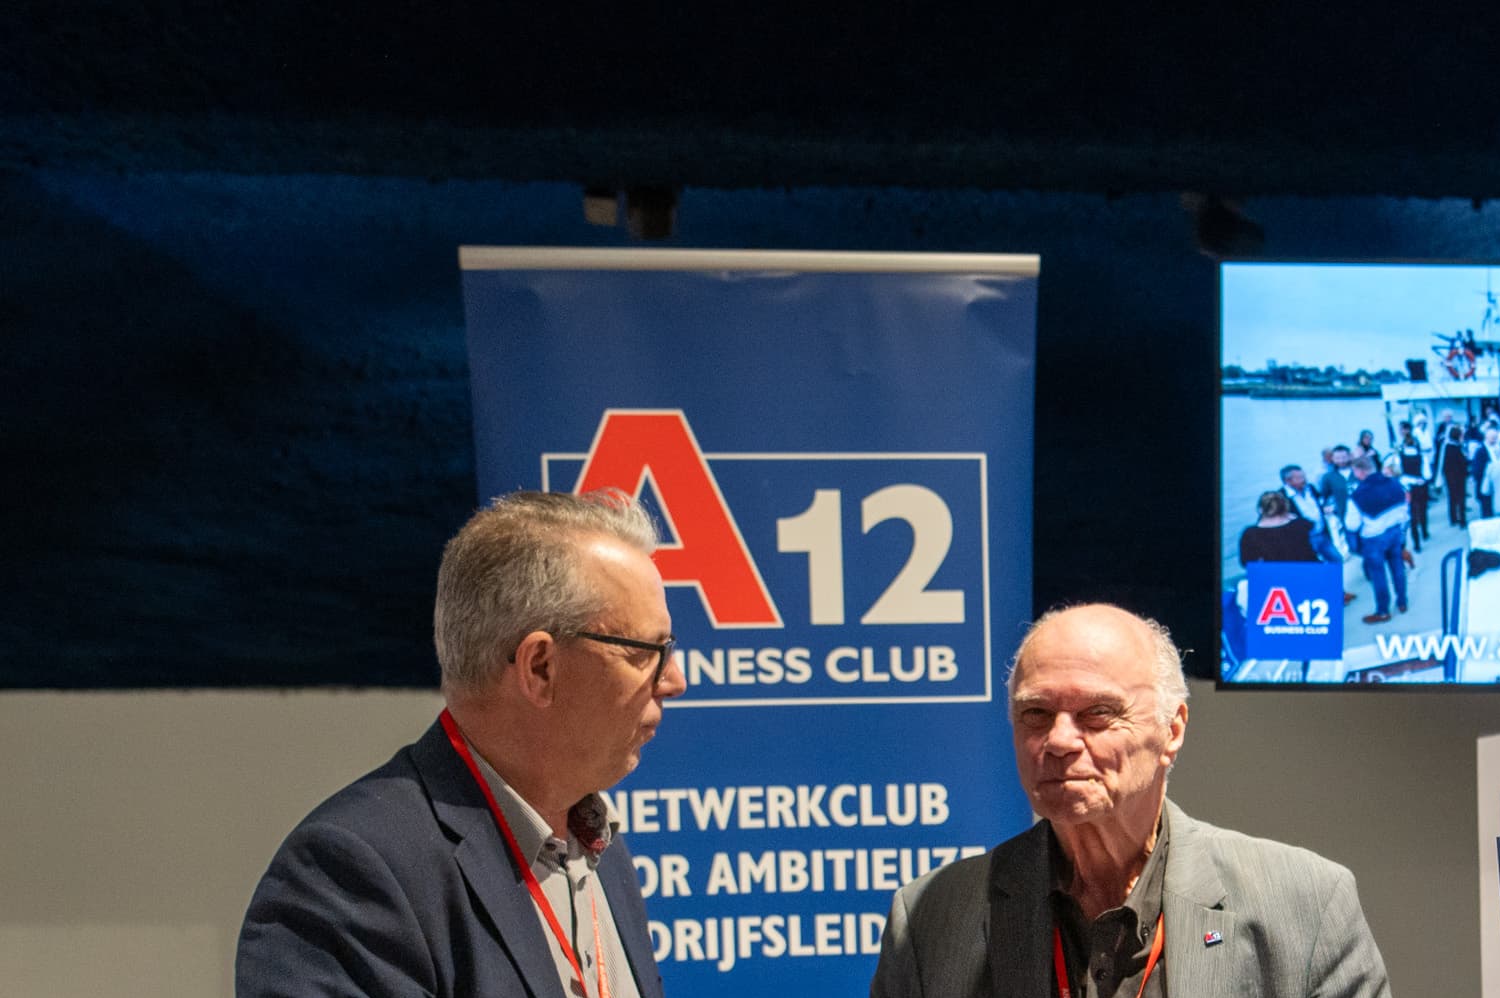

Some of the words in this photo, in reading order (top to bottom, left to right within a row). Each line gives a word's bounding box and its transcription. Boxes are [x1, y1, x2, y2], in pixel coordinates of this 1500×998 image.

[1256, 586, 1330, 625] A12
[824, 646, 958, 683] CLUB
[599, 782, 950, 834] NETWERKCLUB
[632, 854, 692, 899] OR
[647, 913, 887, 973] DRIJFSLEID
